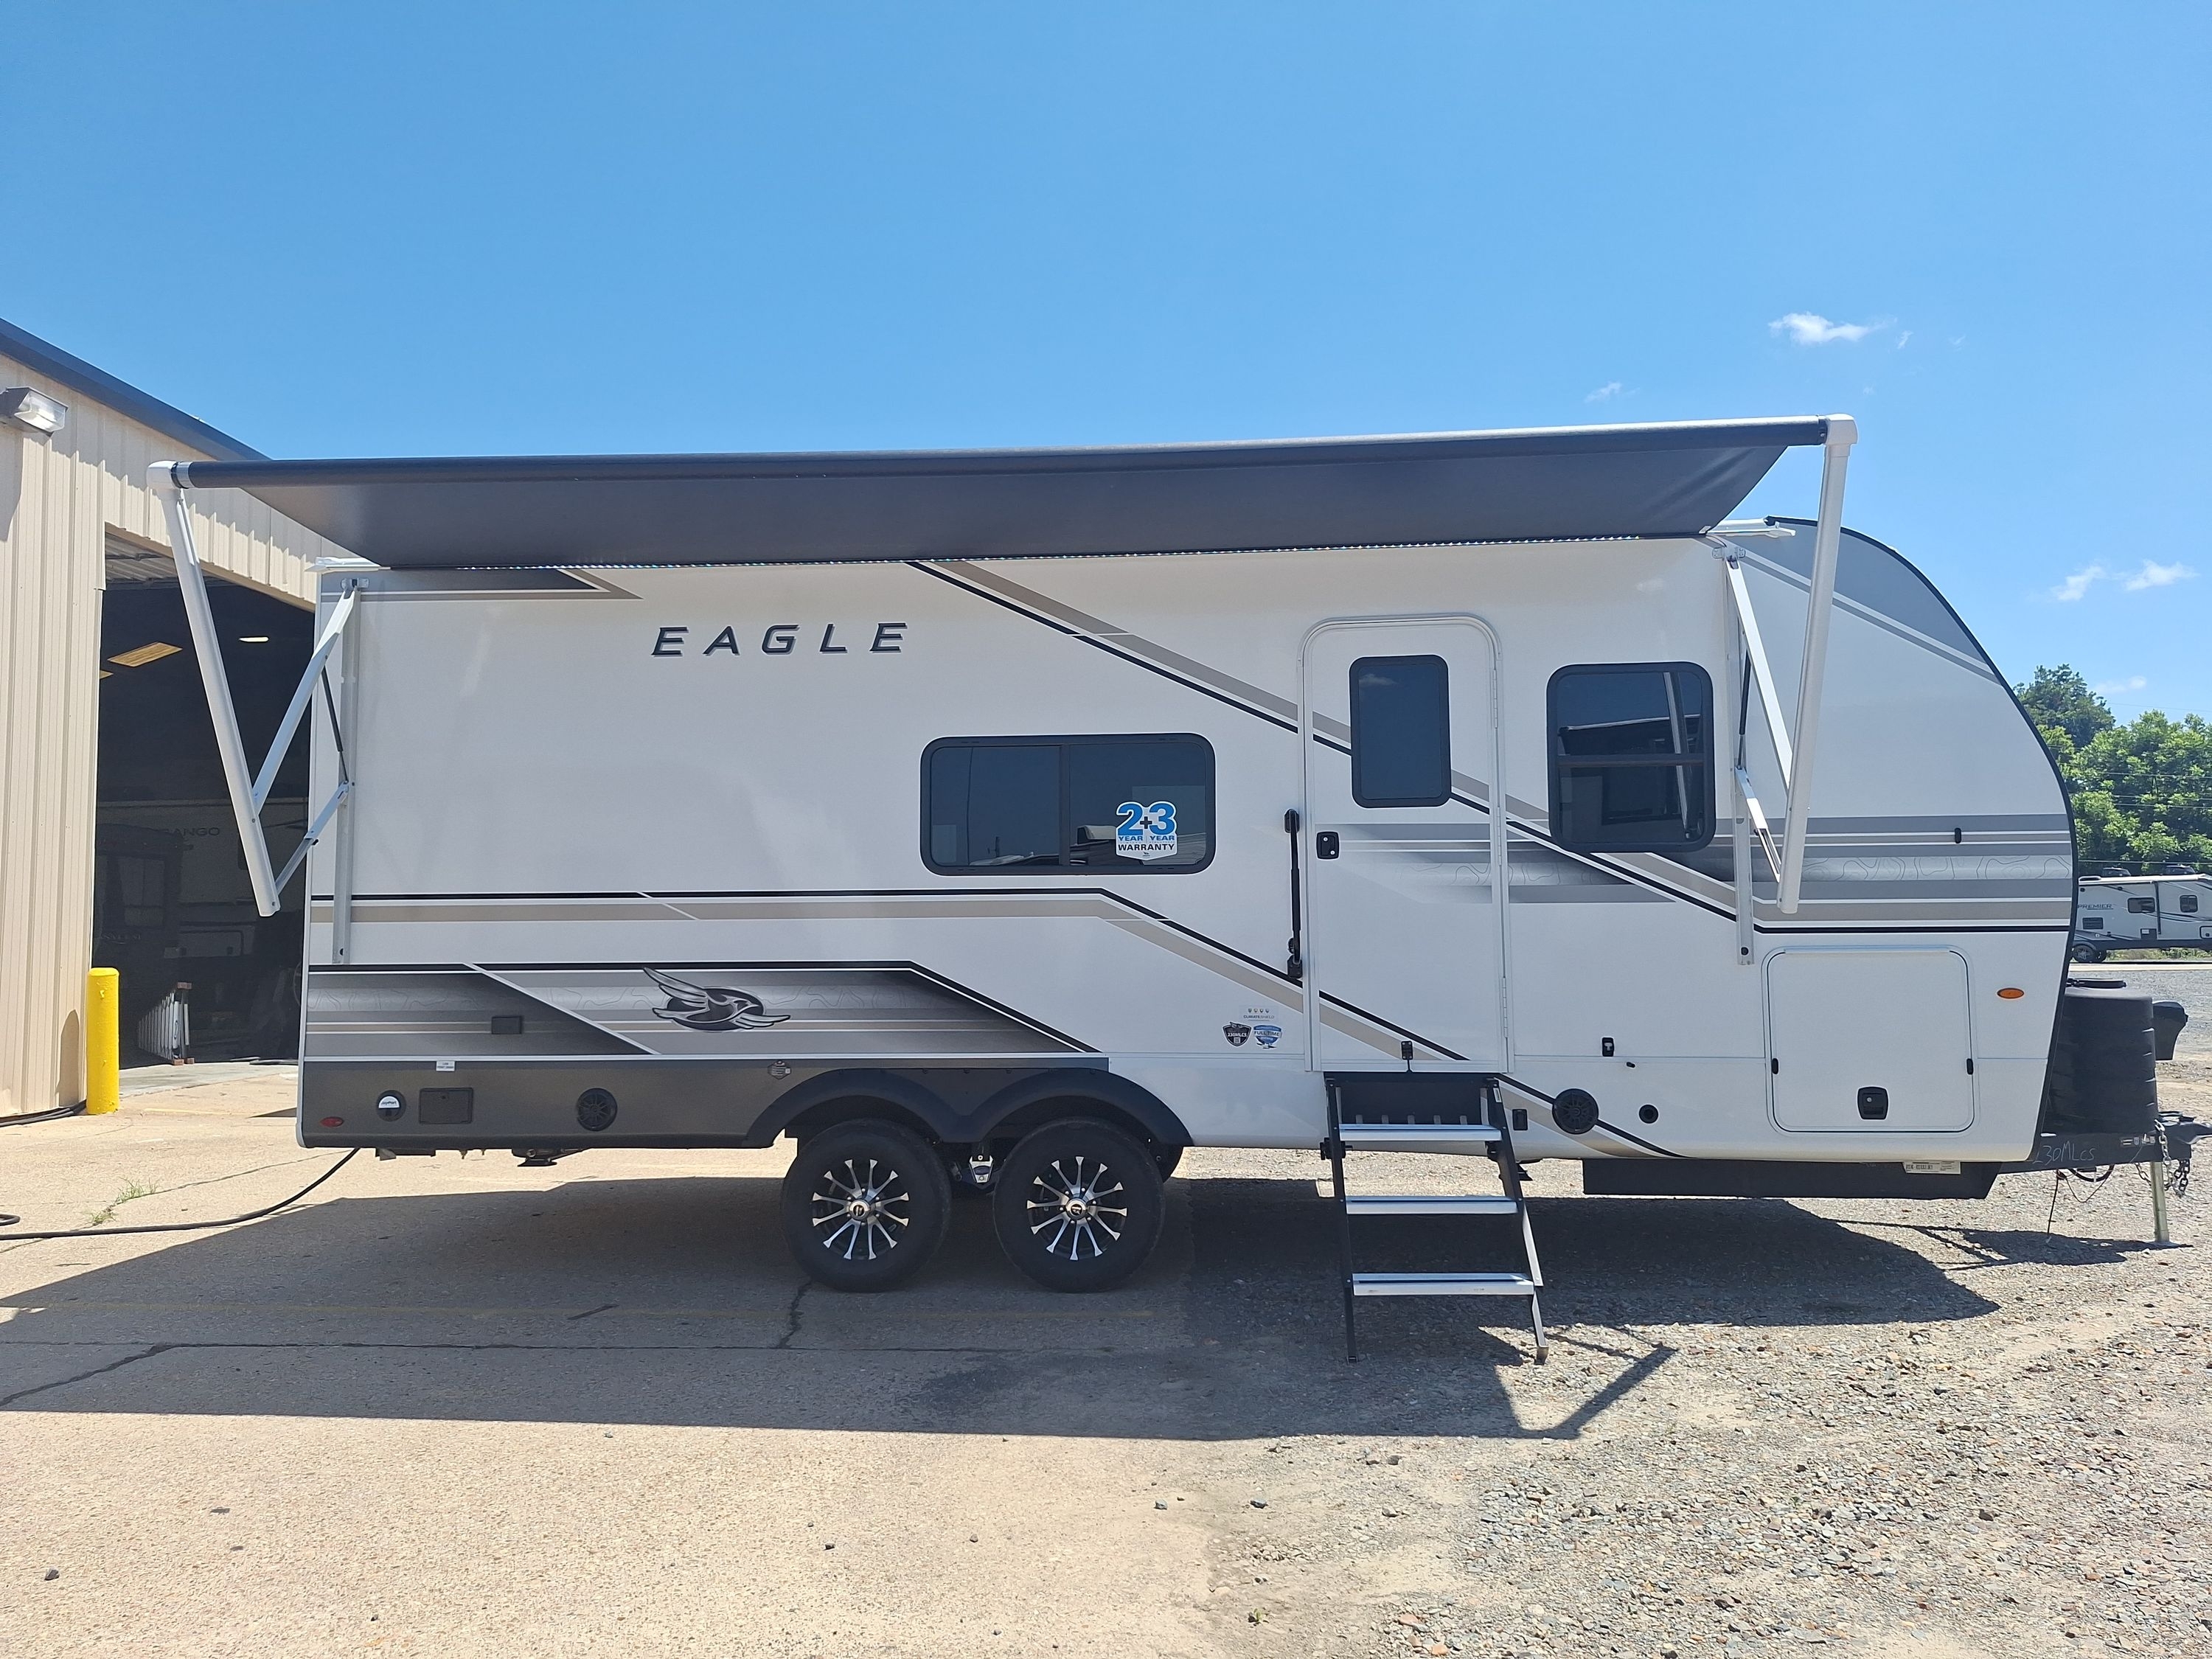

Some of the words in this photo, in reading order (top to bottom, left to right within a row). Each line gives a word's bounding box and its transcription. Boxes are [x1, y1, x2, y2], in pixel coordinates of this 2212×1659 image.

[651, 622, 908, 657] EAGLE
[161, 827, 220, 836] ANGO
[1118, 803, 1175, 835] 2+3
